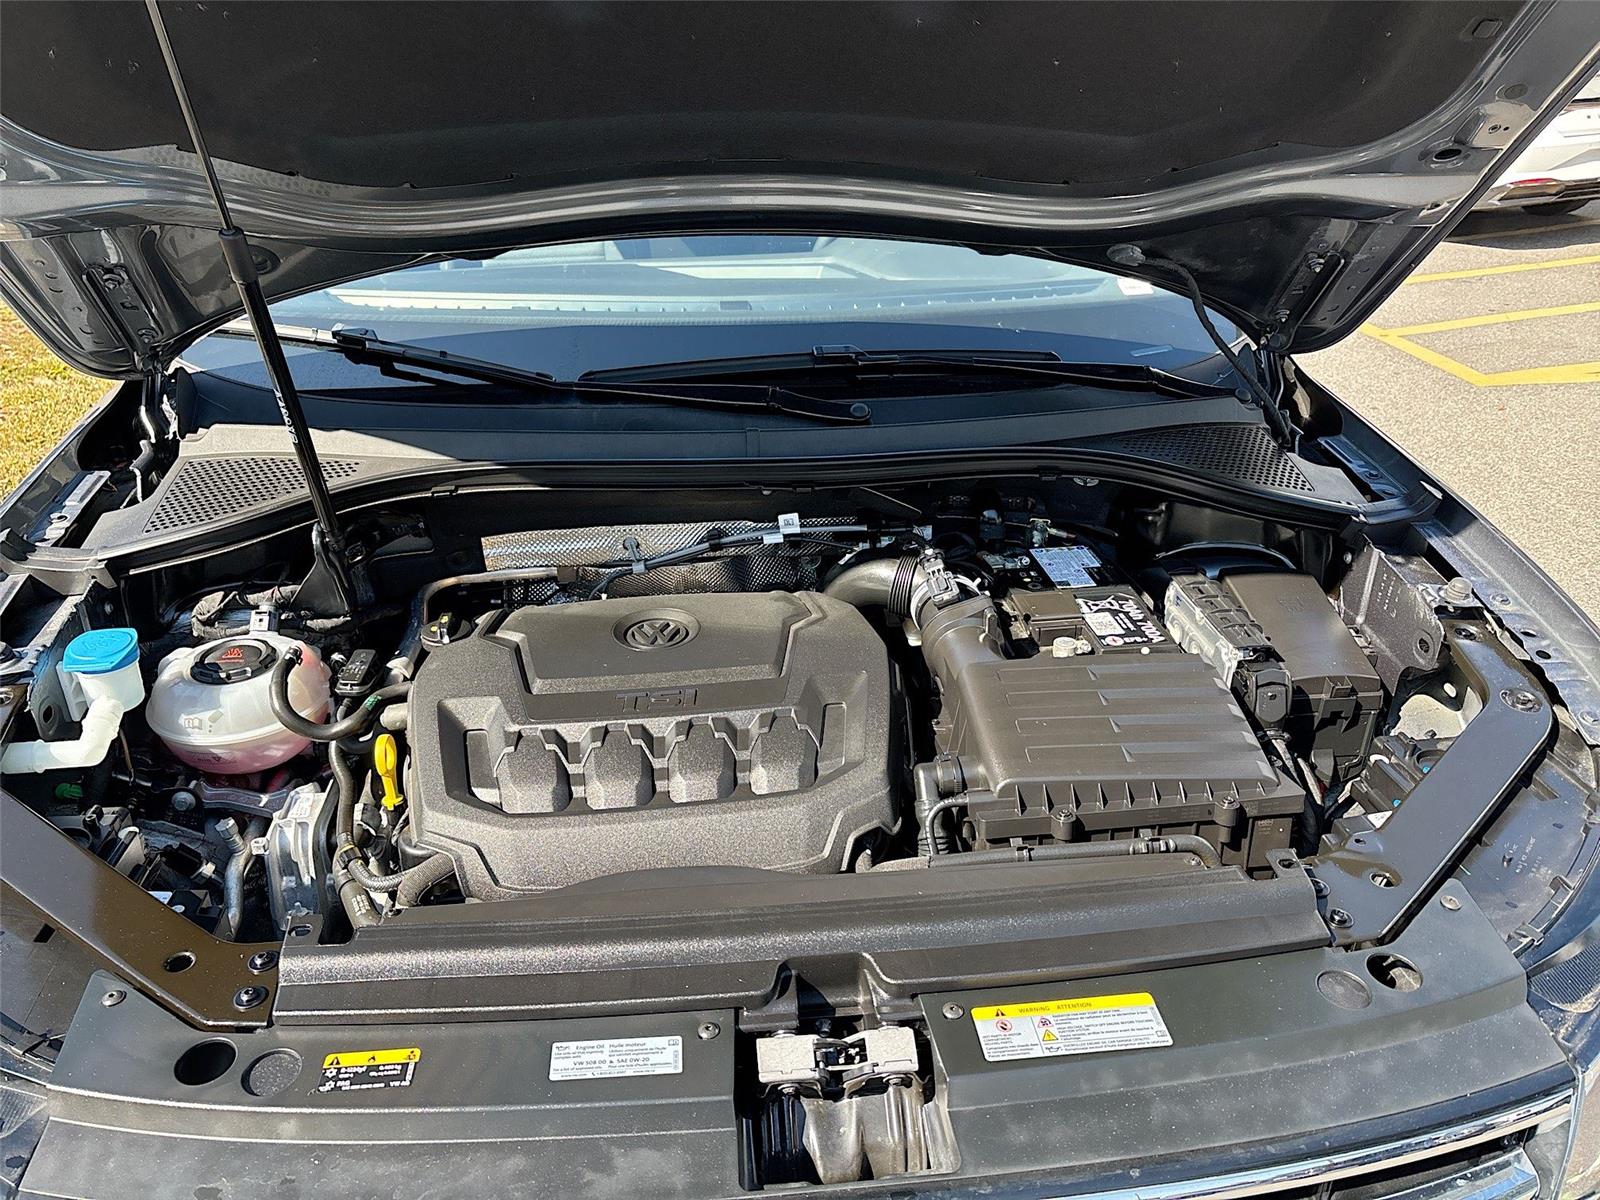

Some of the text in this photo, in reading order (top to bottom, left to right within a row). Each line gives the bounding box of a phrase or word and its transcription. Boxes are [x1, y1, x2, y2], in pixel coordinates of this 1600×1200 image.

[1118, 599, 1145, 620] 70Ah
[1136, 620, 1166, 643] 700A
[616, 688, 699, 712] TSI
[1057, 1002, 1092, 1010] ATTENTION
